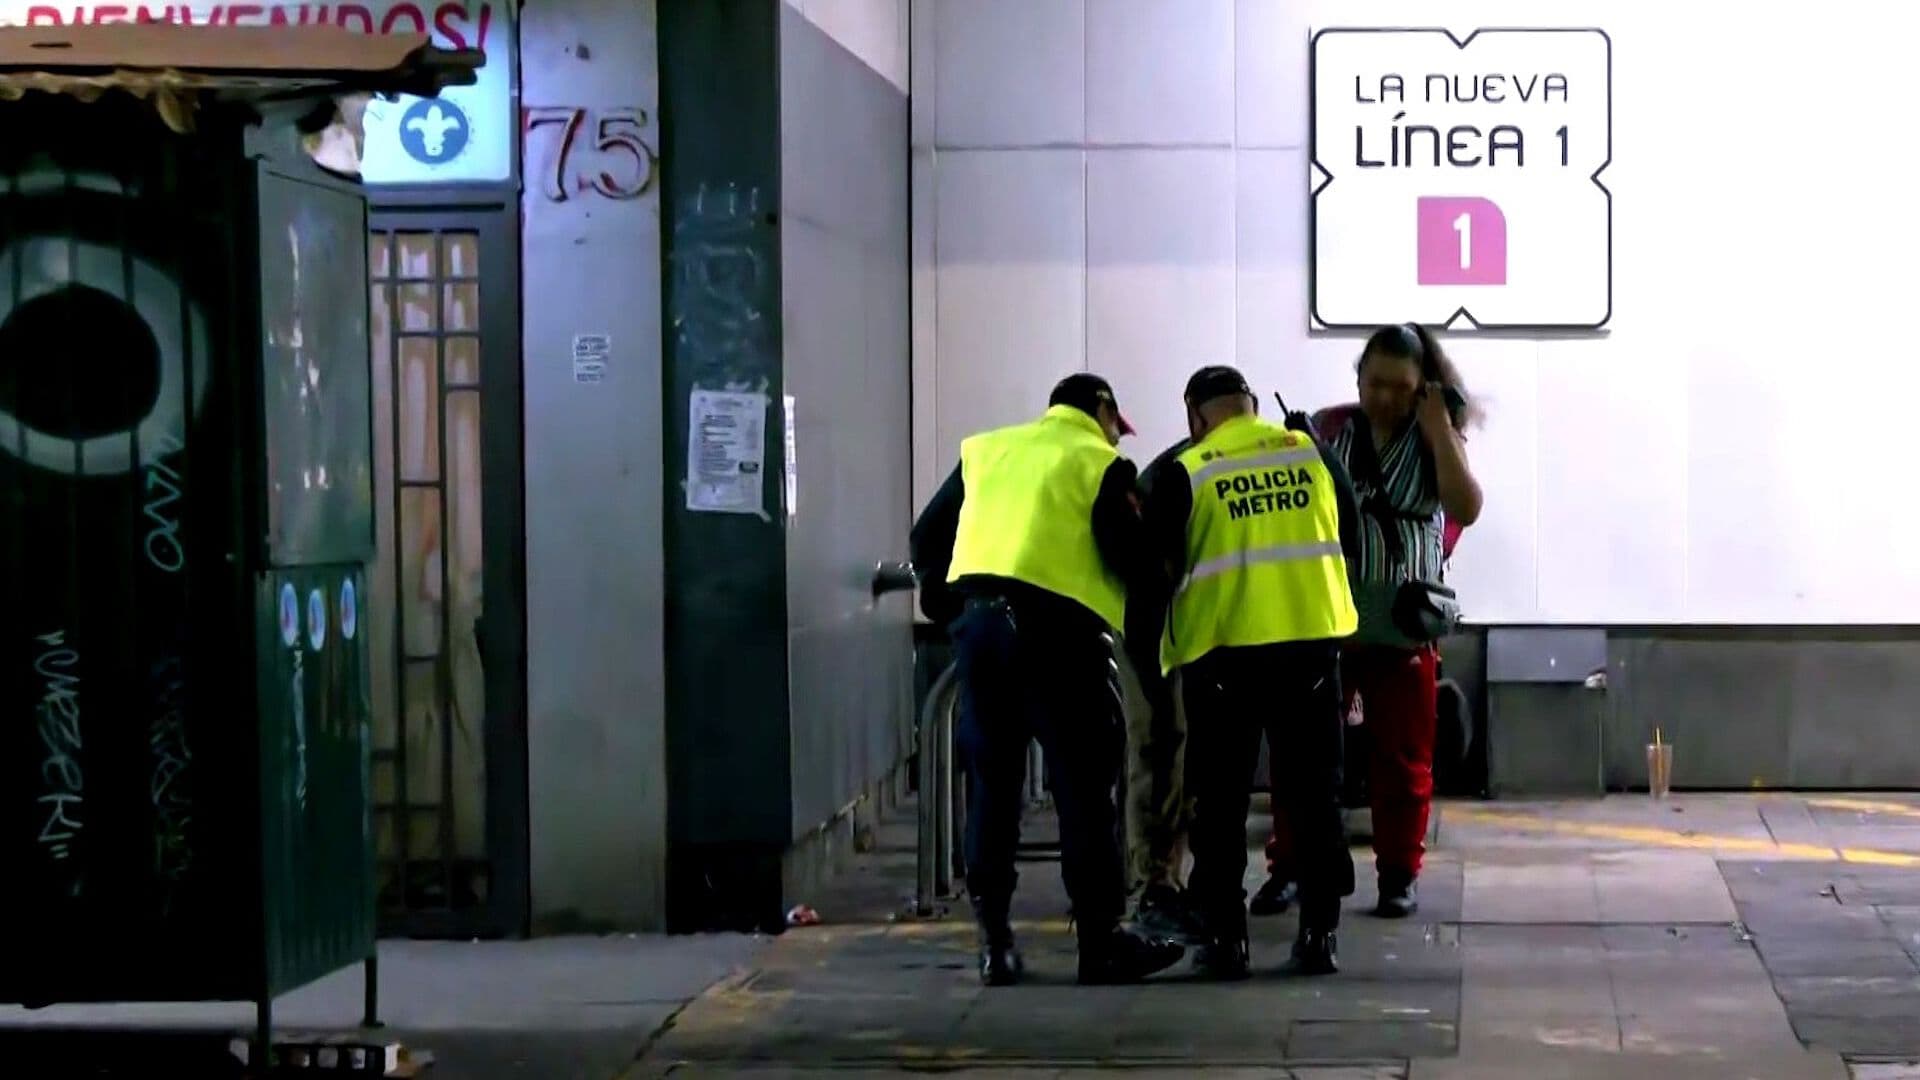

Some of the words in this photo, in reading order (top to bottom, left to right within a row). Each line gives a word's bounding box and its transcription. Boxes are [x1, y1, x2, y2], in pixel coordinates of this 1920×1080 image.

[1355, 73, 1404, 103] LA
[1425, 73, 1568, 103] NUEVA
[523, 106, 654, 203] 75
[1355, 110, 1524, 167] LÍNEA
[1555, 124, 1569, 167] 1
[1453, 212, 1472, 270] 1
[1215, 463, 1313, 500] POLICÍA
[1228, 489, 1311, 520] METRO
